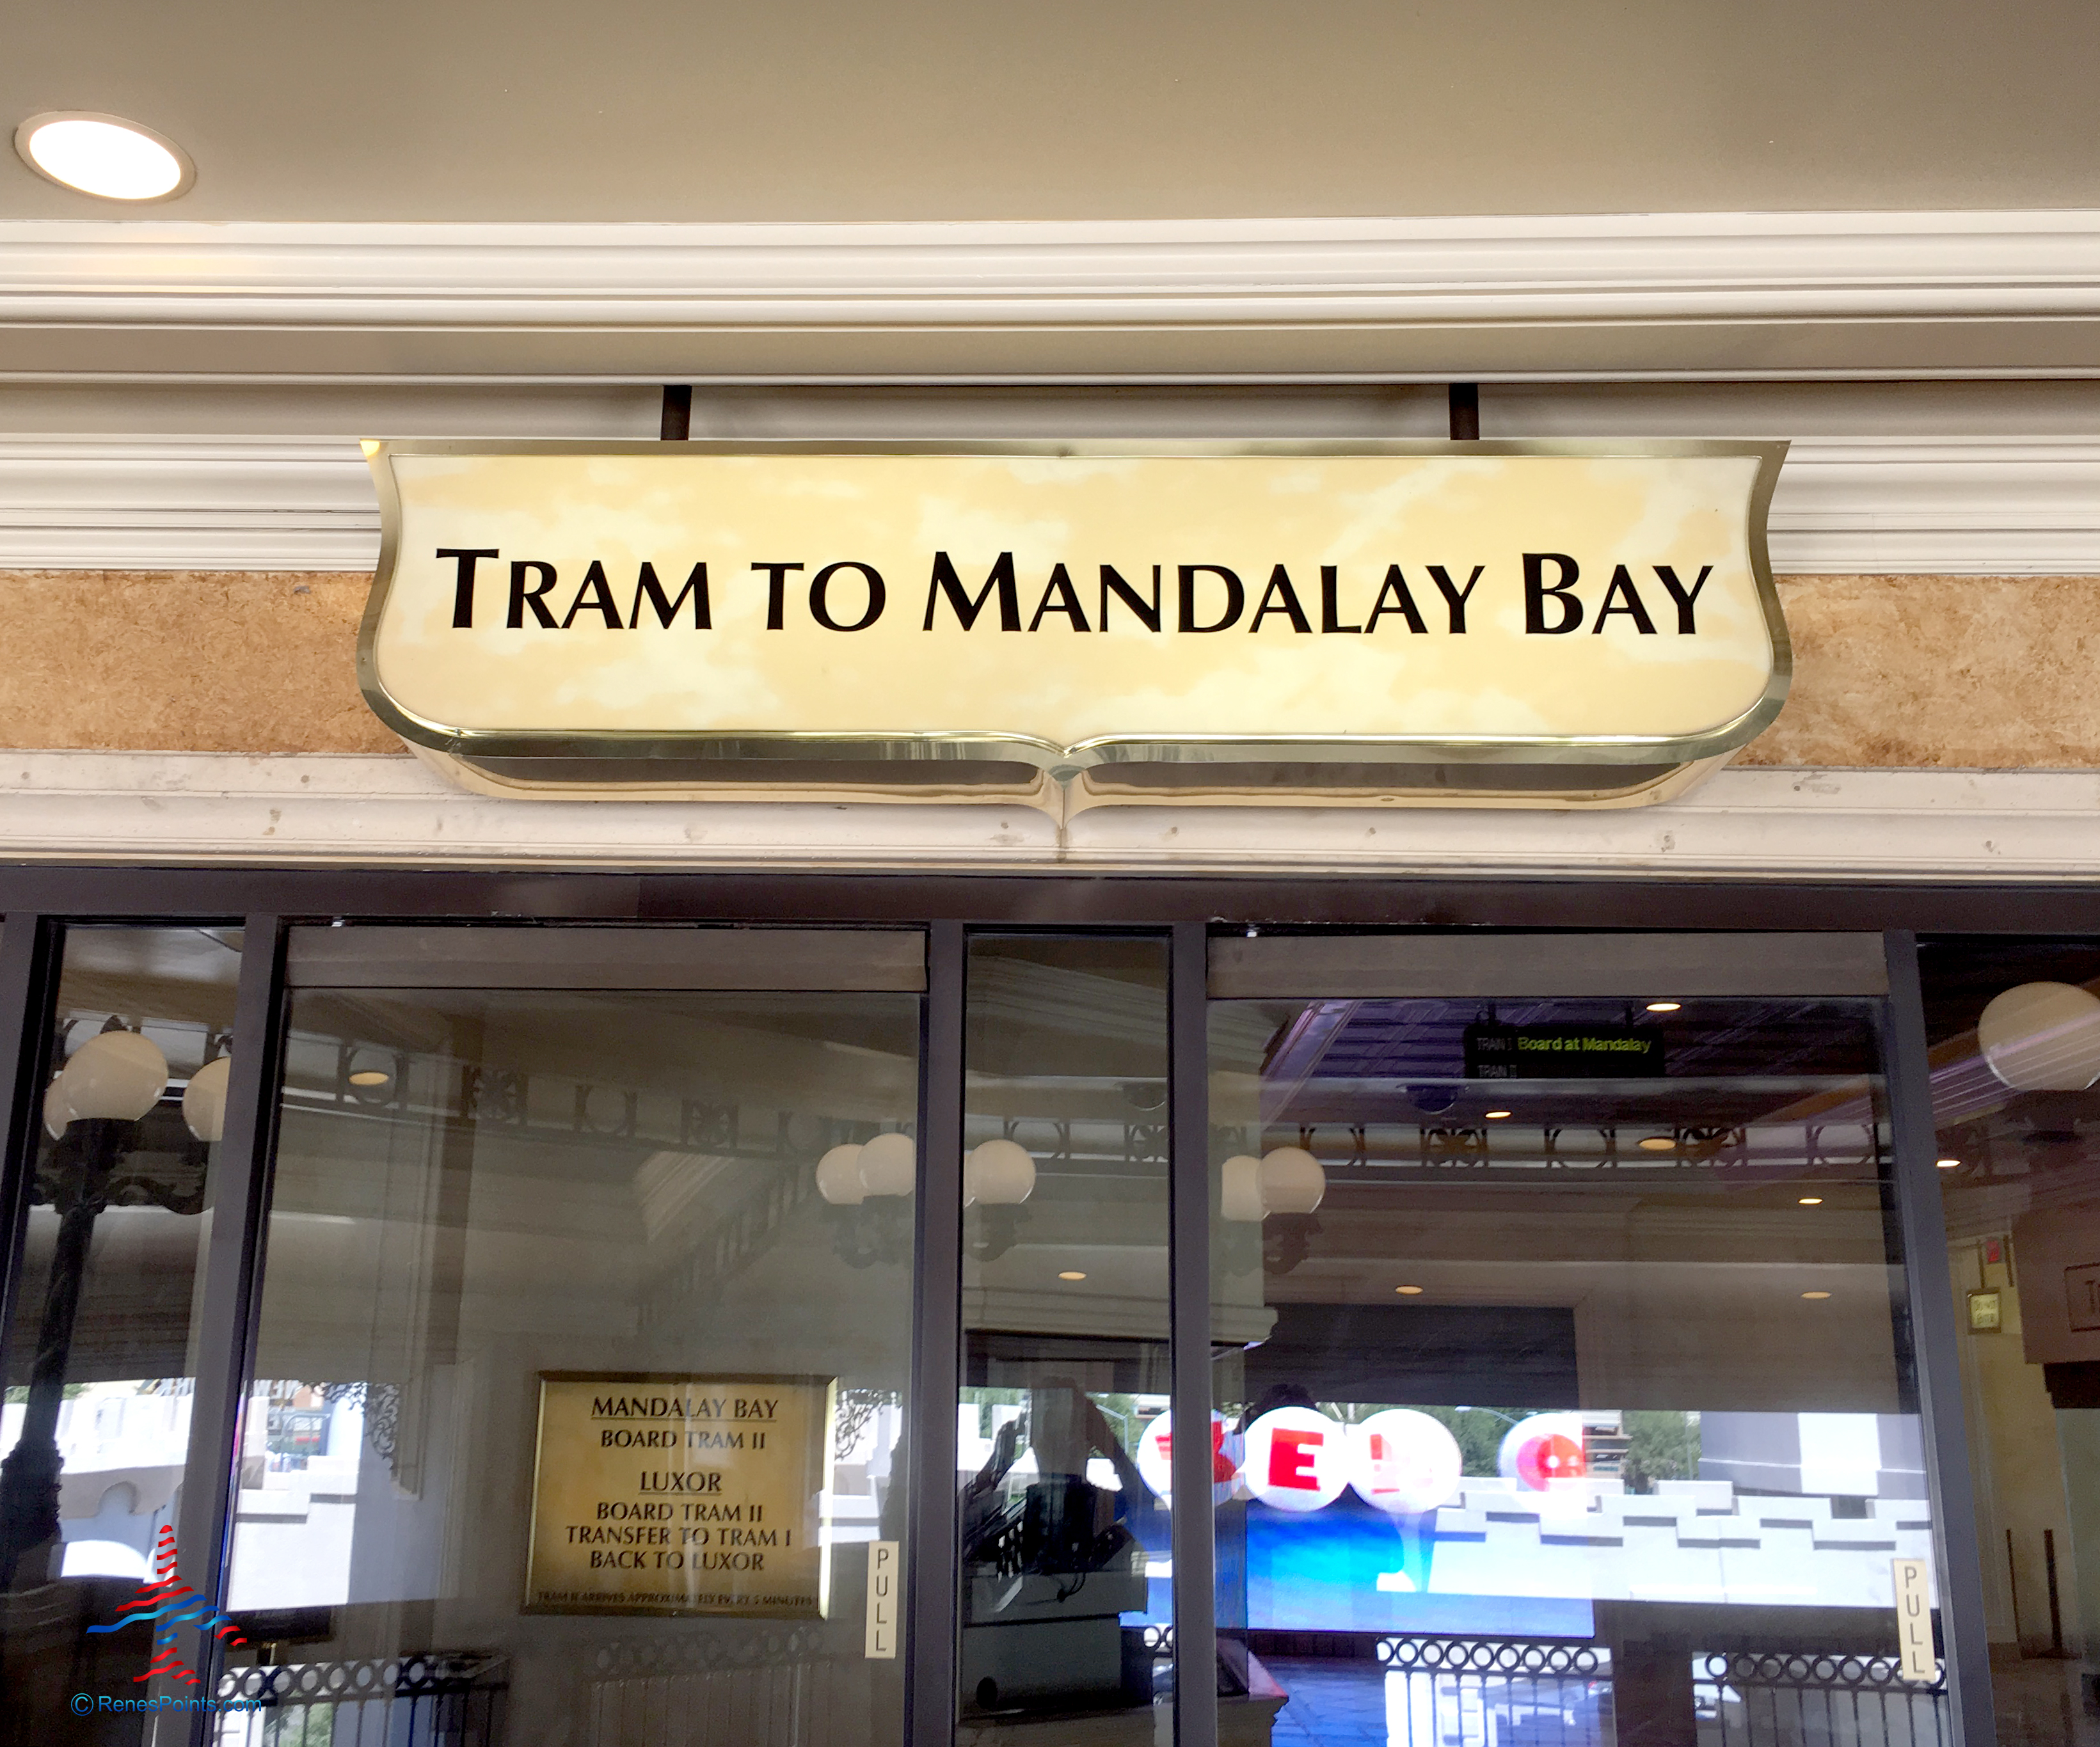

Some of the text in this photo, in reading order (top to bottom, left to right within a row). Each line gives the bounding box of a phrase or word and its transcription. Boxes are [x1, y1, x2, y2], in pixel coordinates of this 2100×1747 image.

[436, 548, 1714, 635] TRAM TO MANDALAY BAY
[1517, 1036, 1562, 1051] Board
[1564, 1038, 1580, 1052] at
[1582, 1037, 1651, 1054] Mandalay
[591, 1396, 778, 1419] MANDALAY BAY
[601, 1429, 765, 1450] BOARD TRAM II
[640, 1471, 722, 1492] LUXOR
[597, 1502, 763, 1522] BOARD TRAM II
[566, 1526, 791, 1547] TRANSFER TO TRAM I
[591, 1551, 765, 1570] BACK TO LUXOR
[875, 1549, 889, 1652] PULL
[1904, 1566, 1925, 1674] PULL
